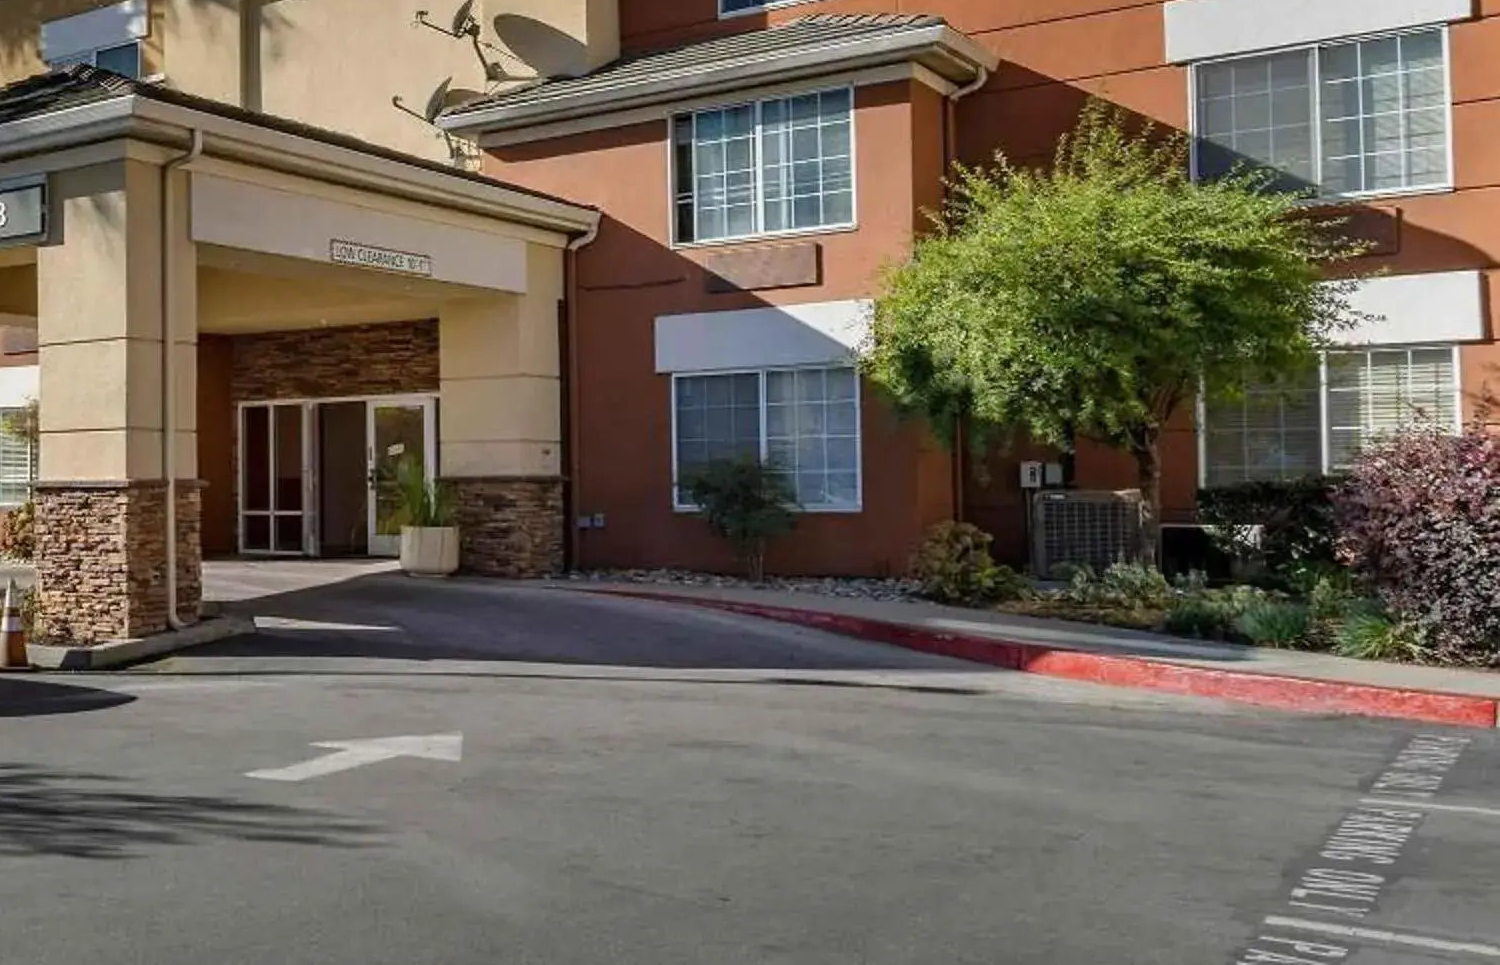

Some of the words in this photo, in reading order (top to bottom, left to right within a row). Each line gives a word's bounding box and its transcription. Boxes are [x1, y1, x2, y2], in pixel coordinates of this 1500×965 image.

[357, 247, 405, 268] CLEARANCE
[1319, 806, 1424, 865] PARKING
[1288, 867, 1385, 917] ONLY
[1236, 935, 1349, 965] PA
